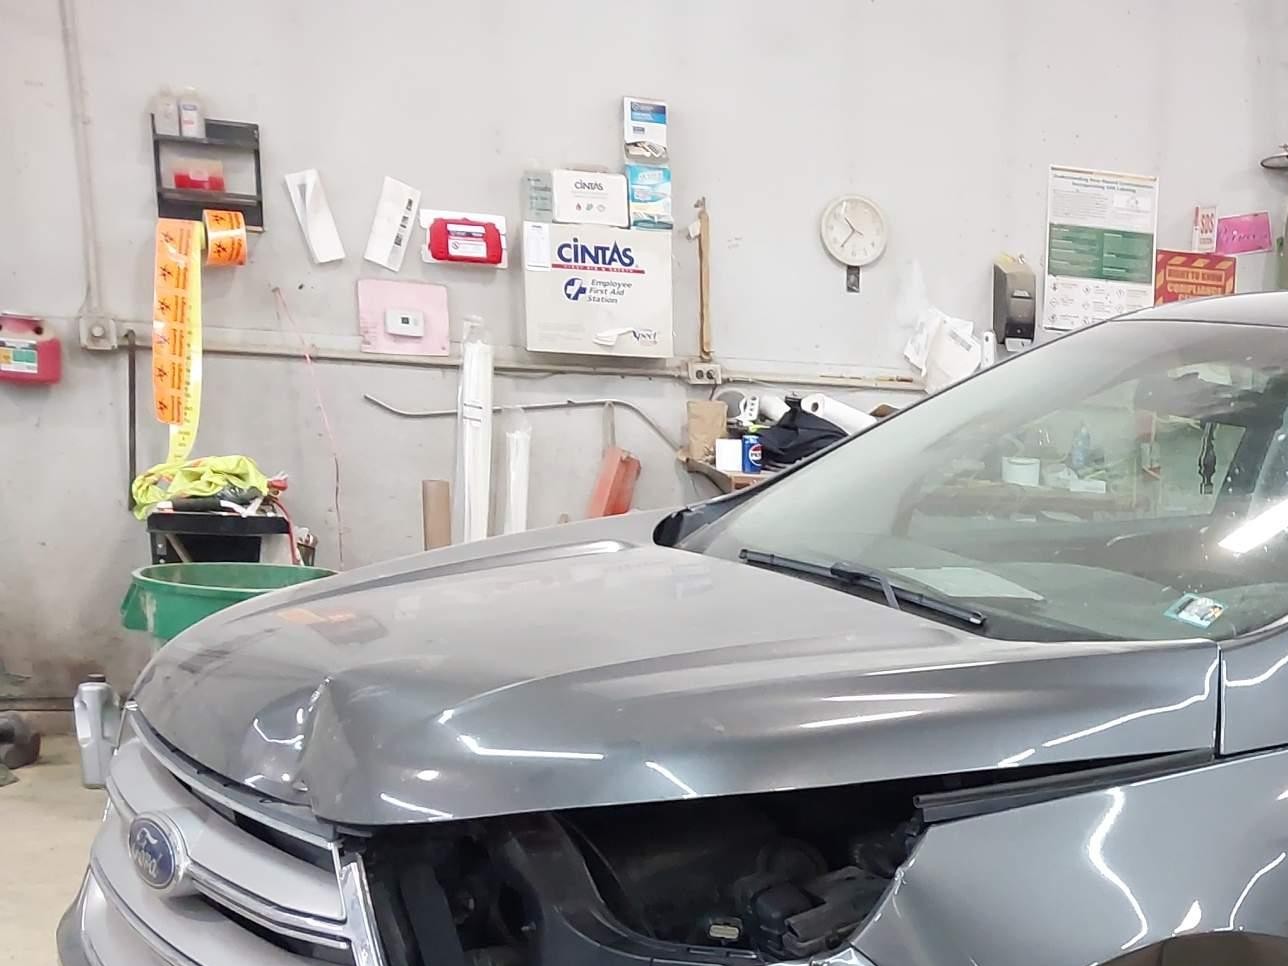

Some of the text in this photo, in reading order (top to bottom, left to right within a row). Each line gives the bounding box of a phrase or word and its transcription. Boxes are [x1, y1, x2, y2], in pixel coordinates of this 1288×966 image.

[592, 279, 632, 289] Employee
[589, 287, 608, 295] First
[587, 295, 618, 304] Station
[132, 827, 163, 879] Ford
